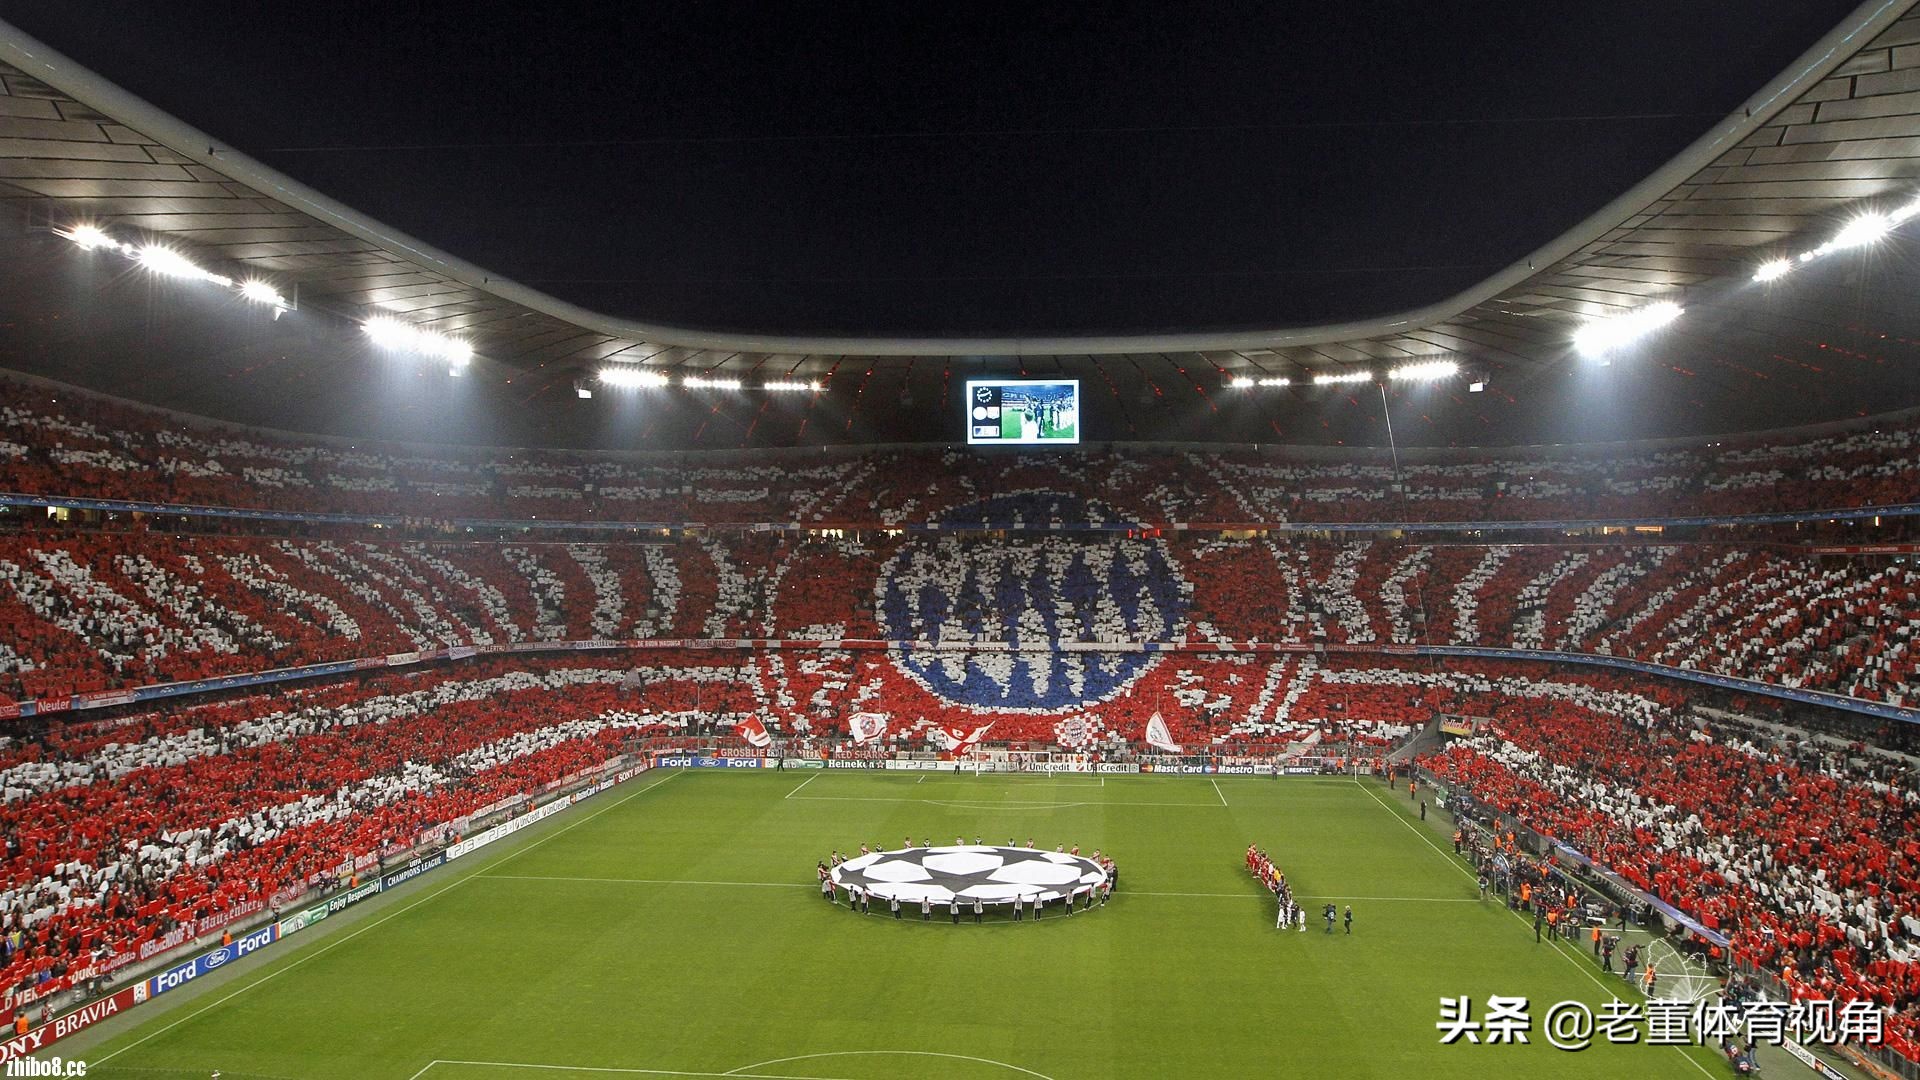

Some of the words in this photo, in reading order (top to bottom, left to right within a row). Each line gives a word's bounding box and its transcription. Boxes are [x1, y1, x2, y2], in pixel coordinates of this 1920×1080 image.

[662, 758, 692, 767] Ford
[854, 751, 889, 760] SHARKS
[727, 758, 757, 768] Ford
[1029, 763, 1070, 771] UniCredit
[1086, 763, 1127, 772] UiCredit
[1154, 765, 1203, 774] MasteCard
[1217, 765, 1253, 774] Maestro
[618, 769, 634, 783] SONY
[519, 809, 541, 827] UniCredit
[488, 824, 509, 842] PS3
[454, 838, 475, 857] PS3
[409, 858, 422, 868] UEFA
[387, 863, 421, 887] CHAMPIONS
[421, 855, 442, 872] LEAGUE
[329, 898, 347, 912] Enjoy
[347, 881, 380, 904] Responsibly
[237, 927, 270, 956] Ford
[157, 960, 197, 993] Ford
[0, 1027, 47, 1065] ONY
[55, 997, 118, 1039] BRAVIA
